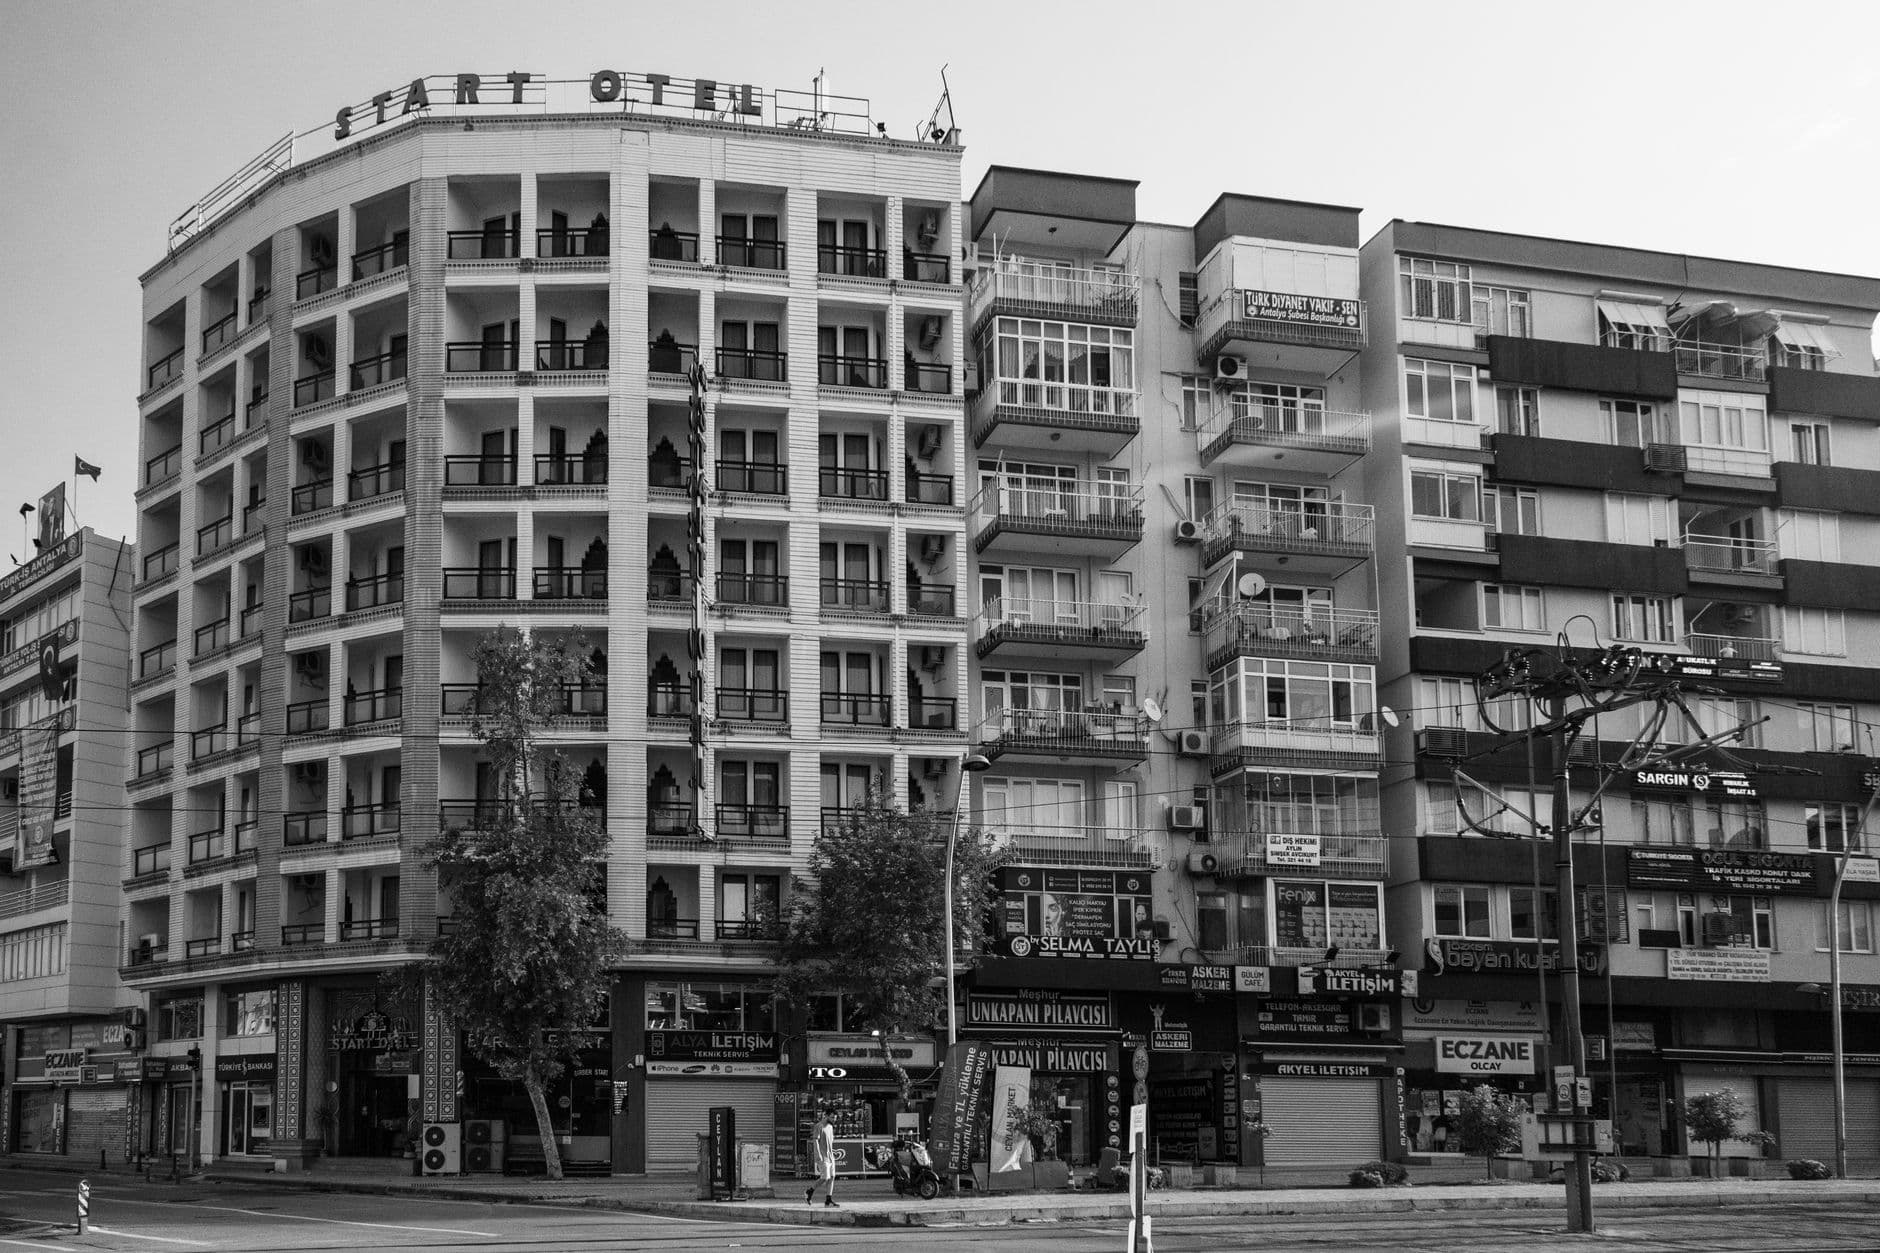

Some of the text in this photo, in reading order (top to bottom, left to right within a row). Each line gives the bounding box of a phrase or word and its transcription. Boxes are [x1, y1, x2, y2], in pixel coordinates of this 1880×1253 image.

[335, 70, 762, 141] START OTEL
[1246, 291, 1358, 316] TÜRK DİYANET VAKIF SEN
[1260, 308, 1287, 320] Antalya
[31, 544, 67, 573] ANTALYA
[1637, 771, 1689, 786] SARGIN
[1277, 886, 1317, 905] Fenix
[1040, 936, 1095, 952] SELMA
[1103, 938, 1151, 954] TAYLI
[1446, 947, 1511, 973] bayan
[1191, 965, 1230, 980] ASKERİ
[1335, 969, 1361, 978] AKYEL
[1191, 979, 1231, 992] MALZEME
[1326, 973, 1395, 996] İLETİŞİM
[1018, 989, 1061, 1001] Meşhur
[971, 1000, 1107, 1026] UNKAPANI PİLAVCISI
[103, 1024, 131, 1043] ECZA
[711, 1032, 774, 1052] İLETİŞİM
[1155, 1032, 1188, 1041] ASKERİ
[693, 1050, 750, 1059] TEKNİK SERVİS
[829, 1047, 868, 1058] CEYLAN
[1442, 1040, 1530, 1060] ECZANE
[45, 1052, 84, 1069] ECZANE
[218, 1061, 273, 1072] TÜRKİYE BANKASI
[656, 1065, 680, 1073] iPhone
[1047, 1048, 1107, 1072] PİLAVCISI
[1470, 1062, 1502, 1071] OLCAY
[1278, 1064, 1370, 1076] AKYEL İLETİŞİM
[966, 1087, 980, 1122] TEKNİK
[973, 1050, 988, 1084] SERVİS
[948, 1046, 977, 1170] Fatura ve TL yükleme
[1006, 1087, 1017, 1117] MARKET
[715, 1113, 723, 1179] CEYLAN
